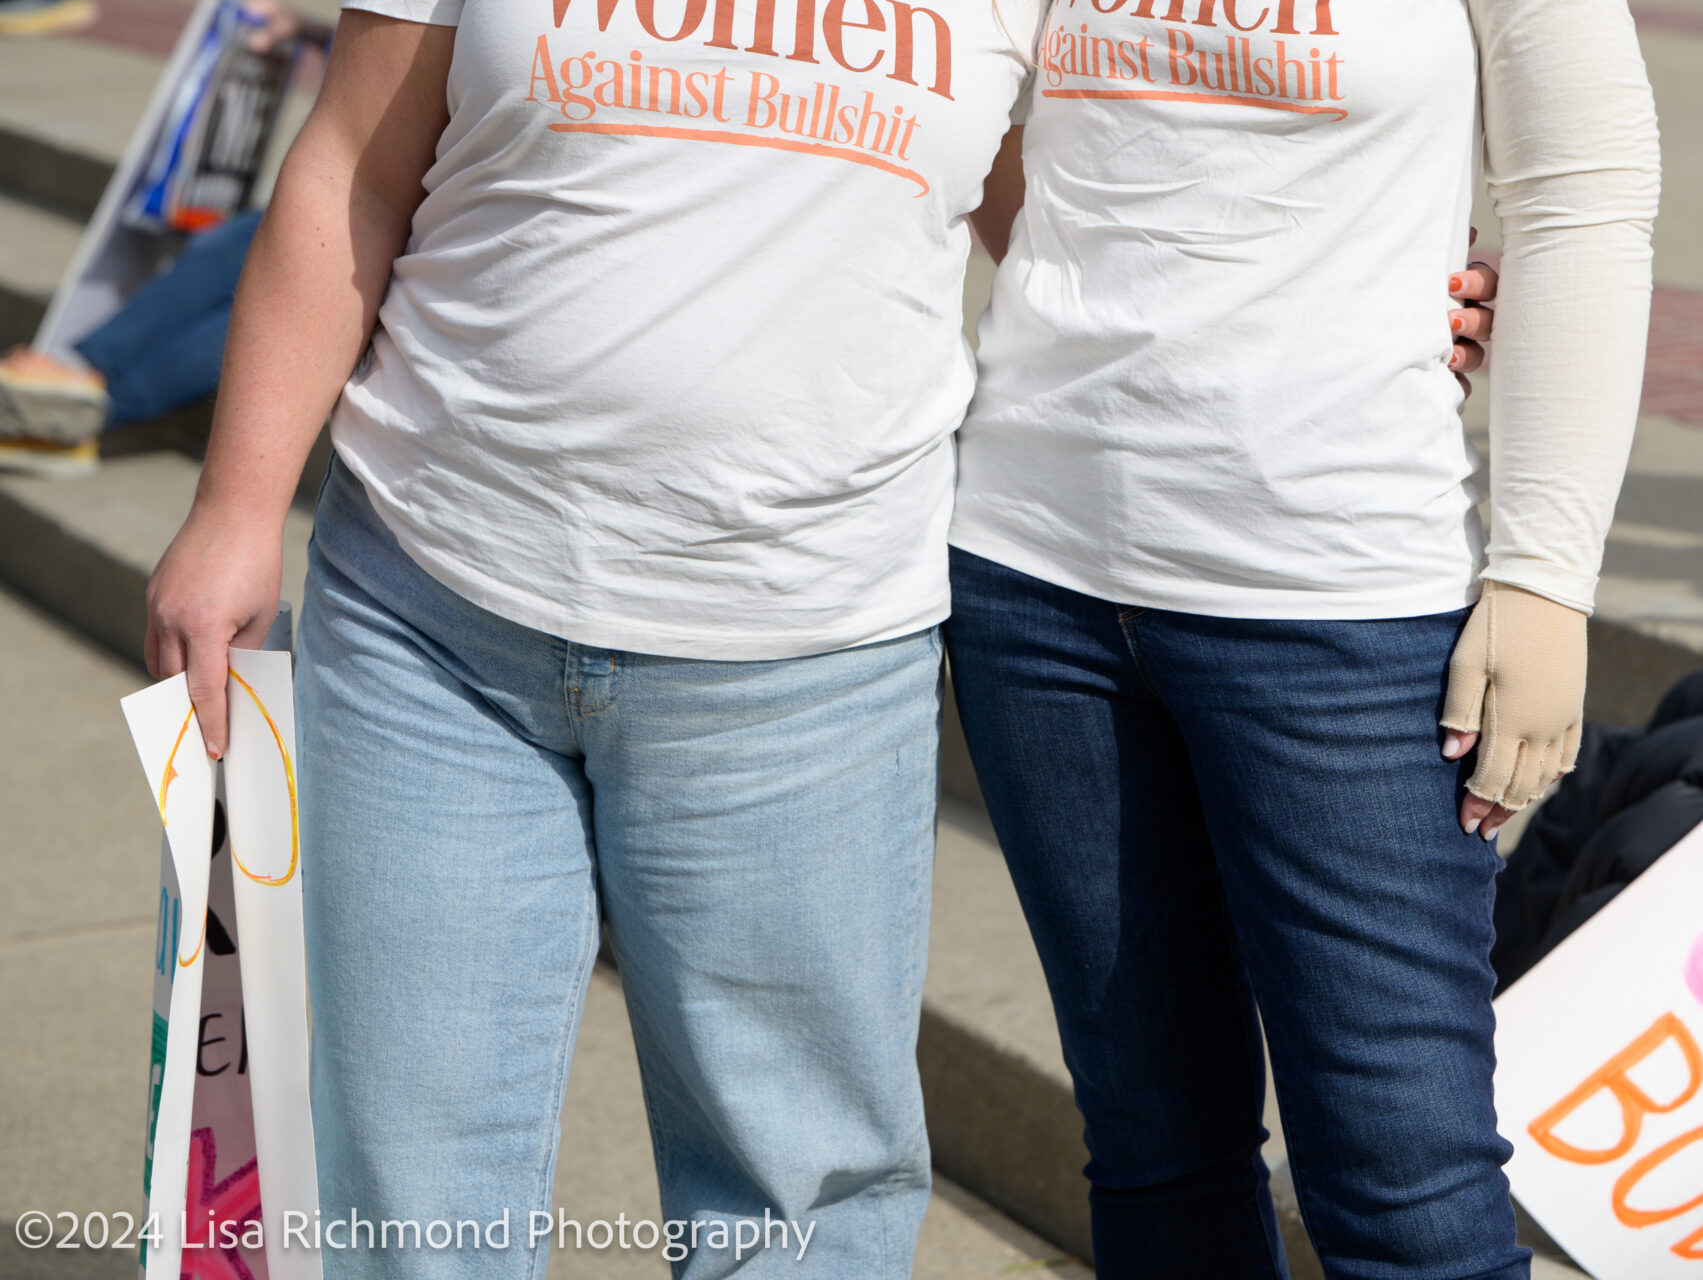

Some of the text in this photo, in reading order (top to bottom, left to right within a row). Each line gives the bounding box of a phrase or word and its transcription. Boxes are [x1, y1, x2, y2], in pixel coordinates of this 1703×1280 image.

[525, 33, 922, 161] Against Bullshit
[1164, 27, 1346, 102] Bullshit
